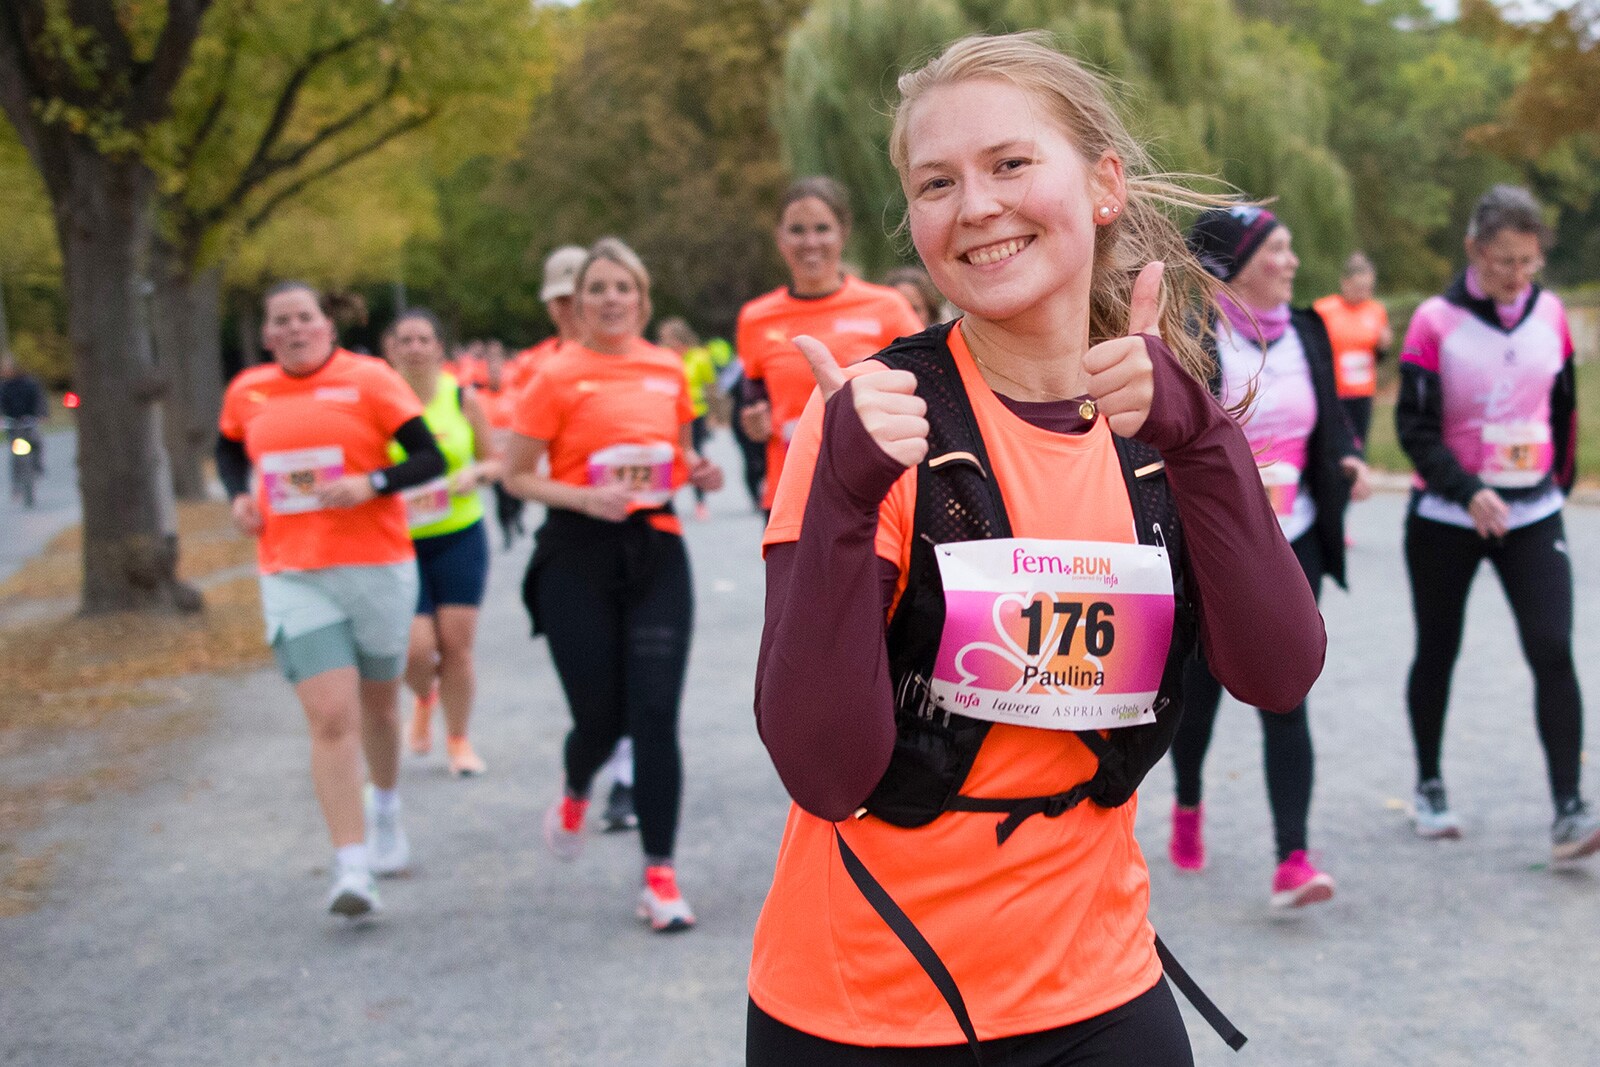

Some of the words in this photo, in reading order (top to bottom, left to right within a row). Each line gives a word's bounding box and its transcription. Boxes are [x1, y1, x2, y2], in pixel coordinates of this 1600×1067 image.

[1012, 547, 1063, 575] fem
[1073, 556, 1111, 575] RUN
[1021, 600, 1115, 657] 176
[1022, 665, 1105, 686] Paulina
[992, 698, 1041, 715] lavera
[1052, 705, 1104, 717] ASPRIA
